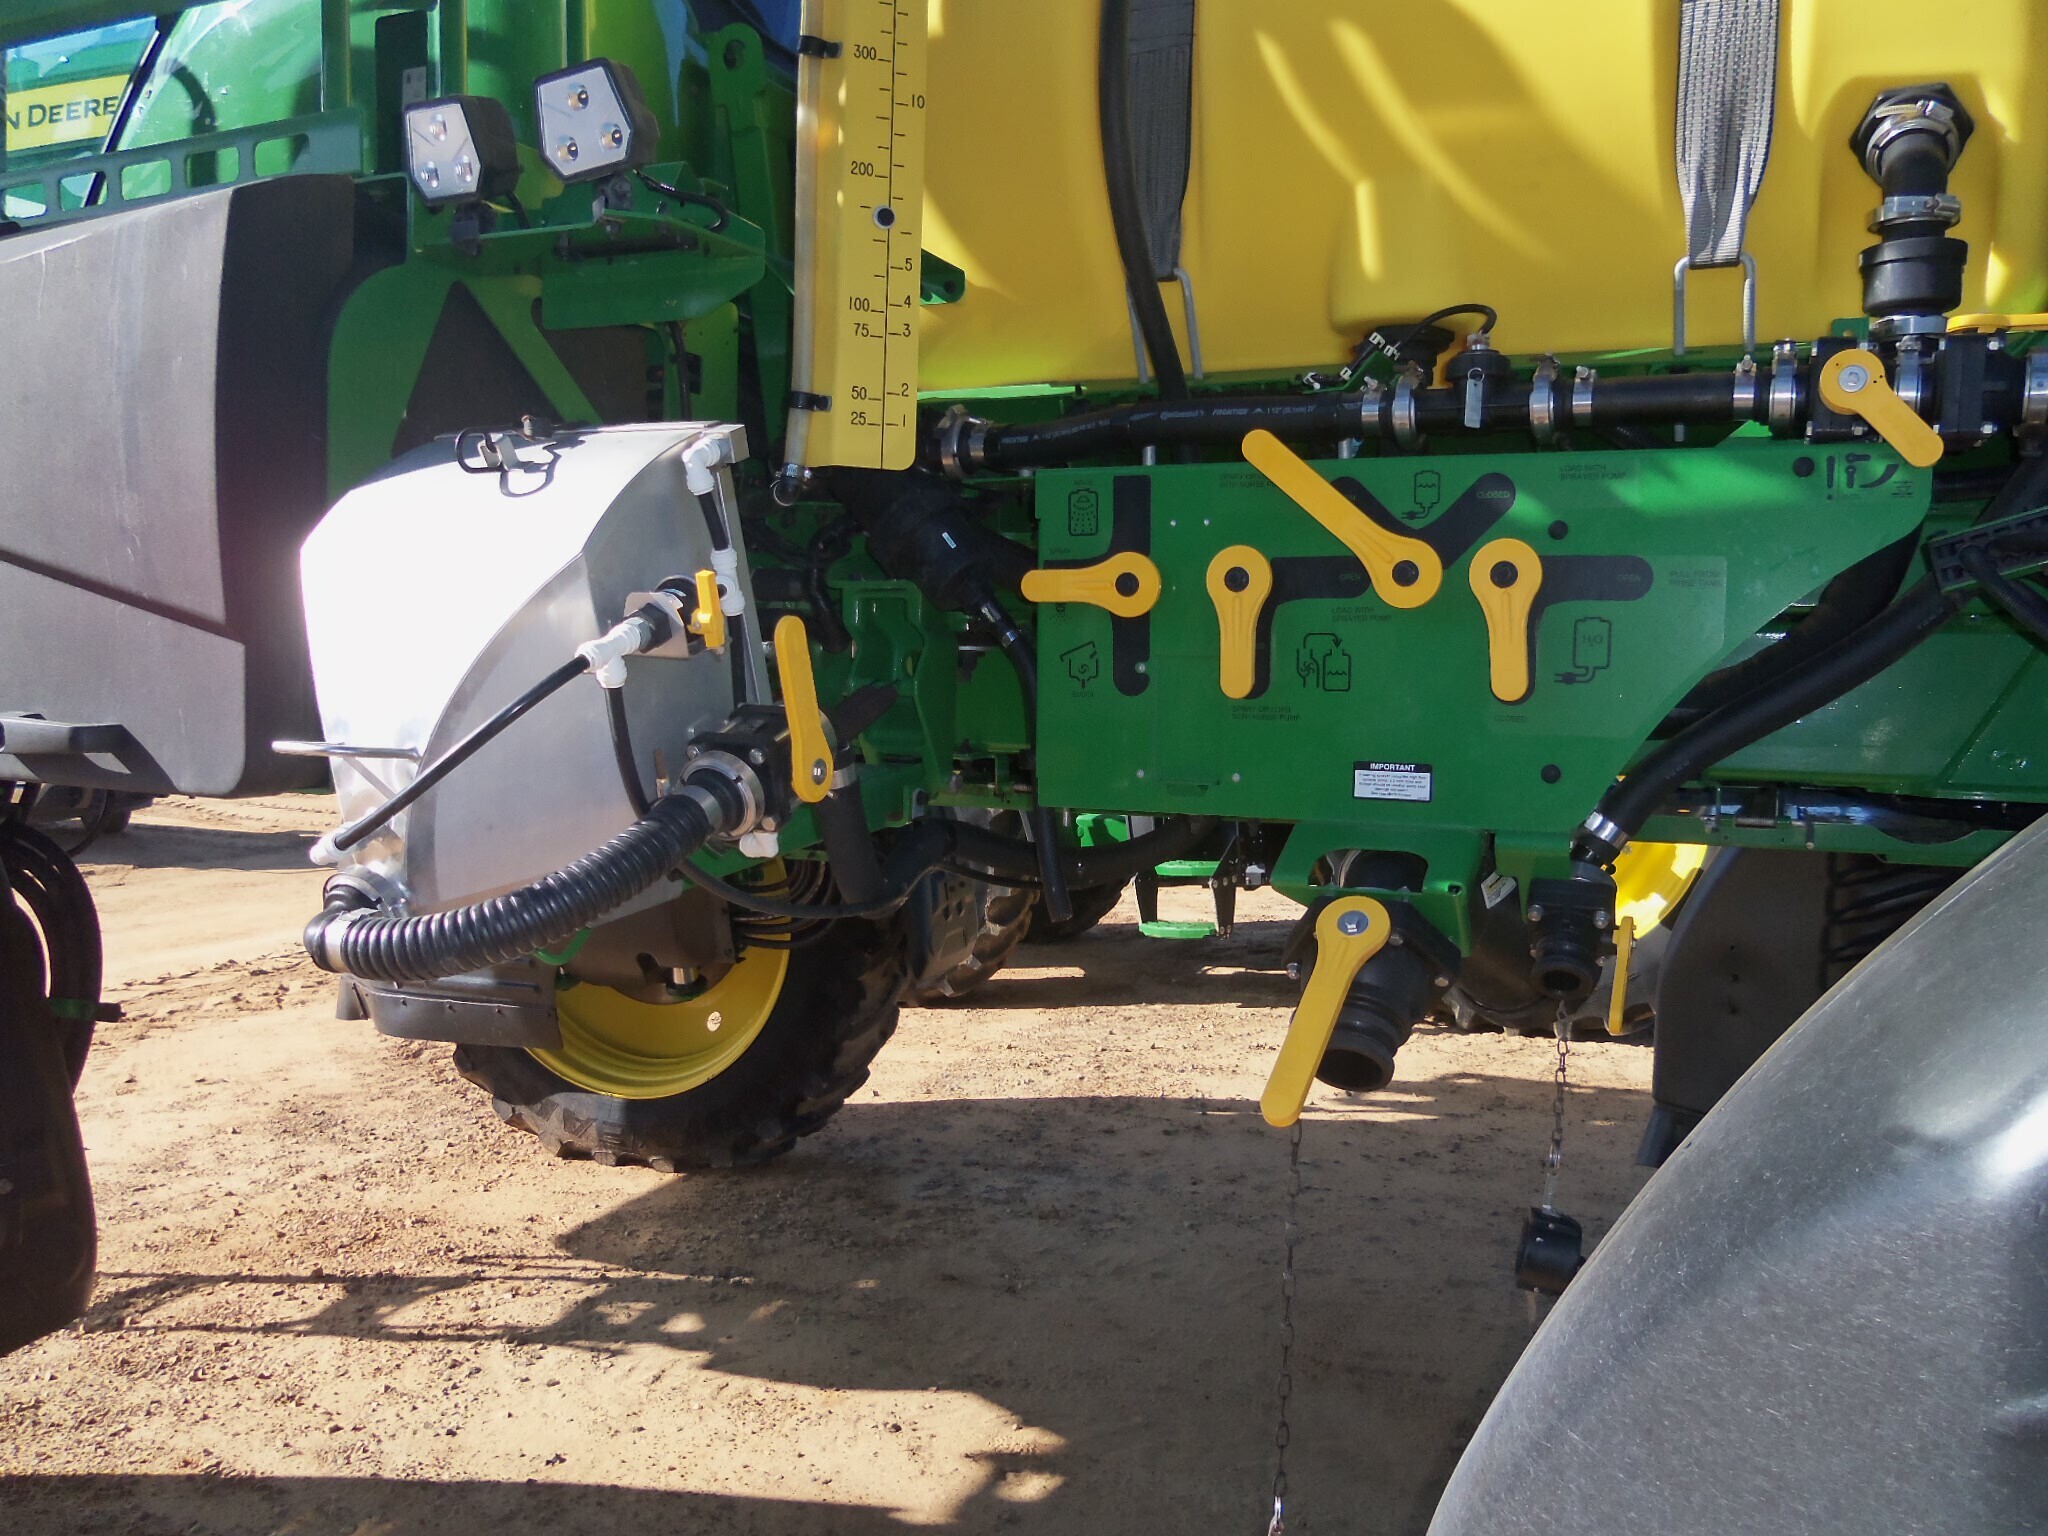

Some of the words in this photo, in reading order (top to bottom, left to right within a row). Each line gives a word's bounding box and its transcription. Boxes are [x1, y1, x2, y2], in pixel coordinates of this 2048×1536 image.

[854, 44, 877, 61] 300
[912, 94, 925, 109] 10
[28, 96, 119, 127] DEERE
[851, 160, 874, 177] 200
[905, 258, 913, 272] 5
[849, 296, 870, 312] 100
[904, 295, 912, 309] 4
[853, 322, 869, 338] 75
[903, 323, 911, 338] 3
[851, 386, 867, 401] 50
[901, 382, 909, 397] 2
[850, 411, 867, 426] 25
[1477, 491, 1510, 500] CLOSED
[1370, 762, 1415, 772] IMPORTANT
